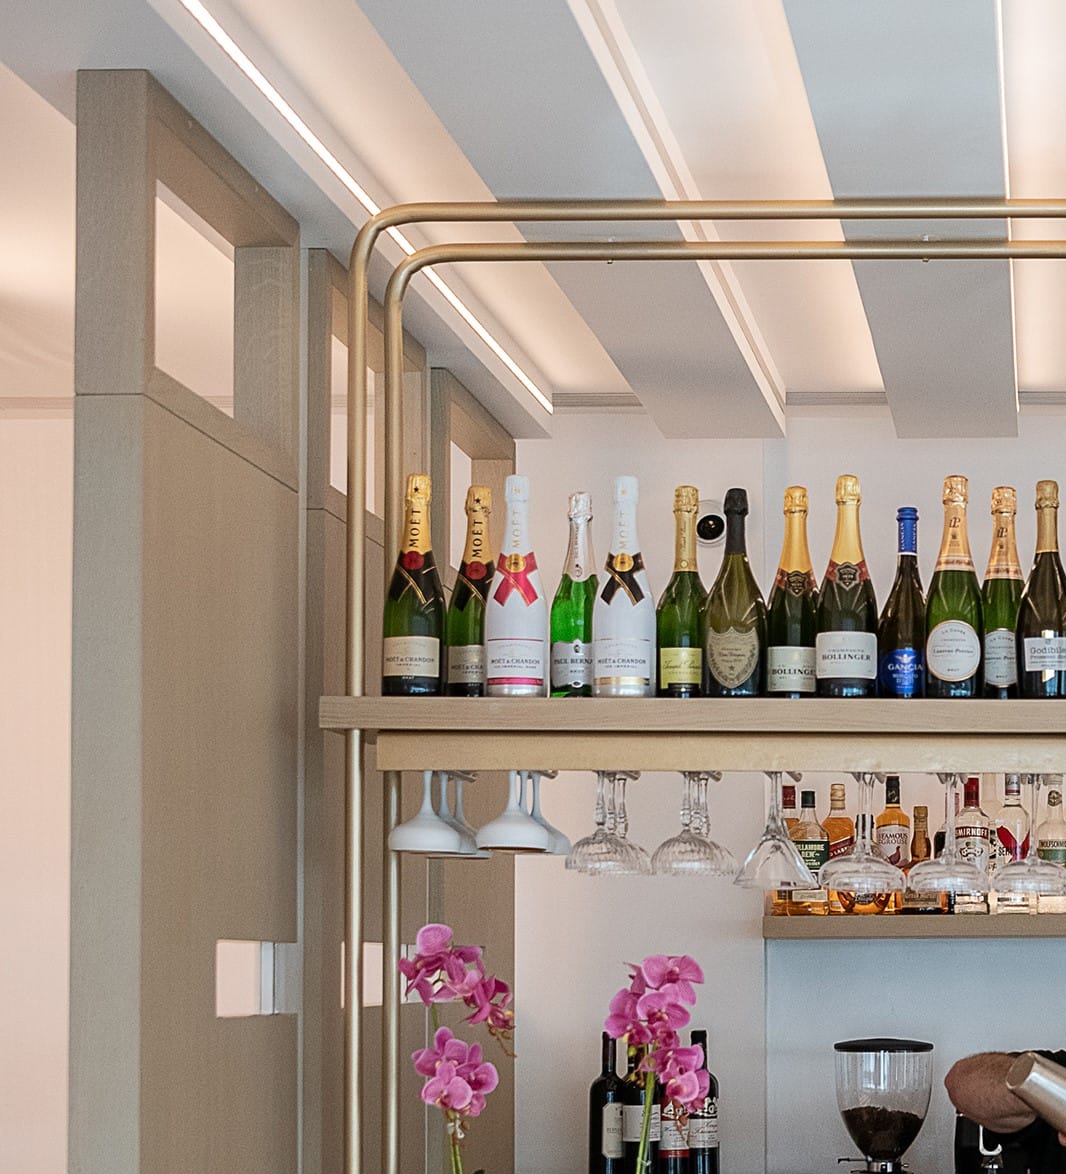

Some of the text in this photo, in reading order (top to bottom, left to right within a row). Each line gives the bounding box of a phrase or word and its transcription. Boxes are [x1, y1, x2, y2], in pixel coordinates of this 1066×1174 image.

[1030, 646, 1066, 654] Godibile
[772, 668, 816, 676] BOLLINGE
[881, 832, 908, 840] FAMOUS
[955, 828, 989, 837] MIRNOFF
